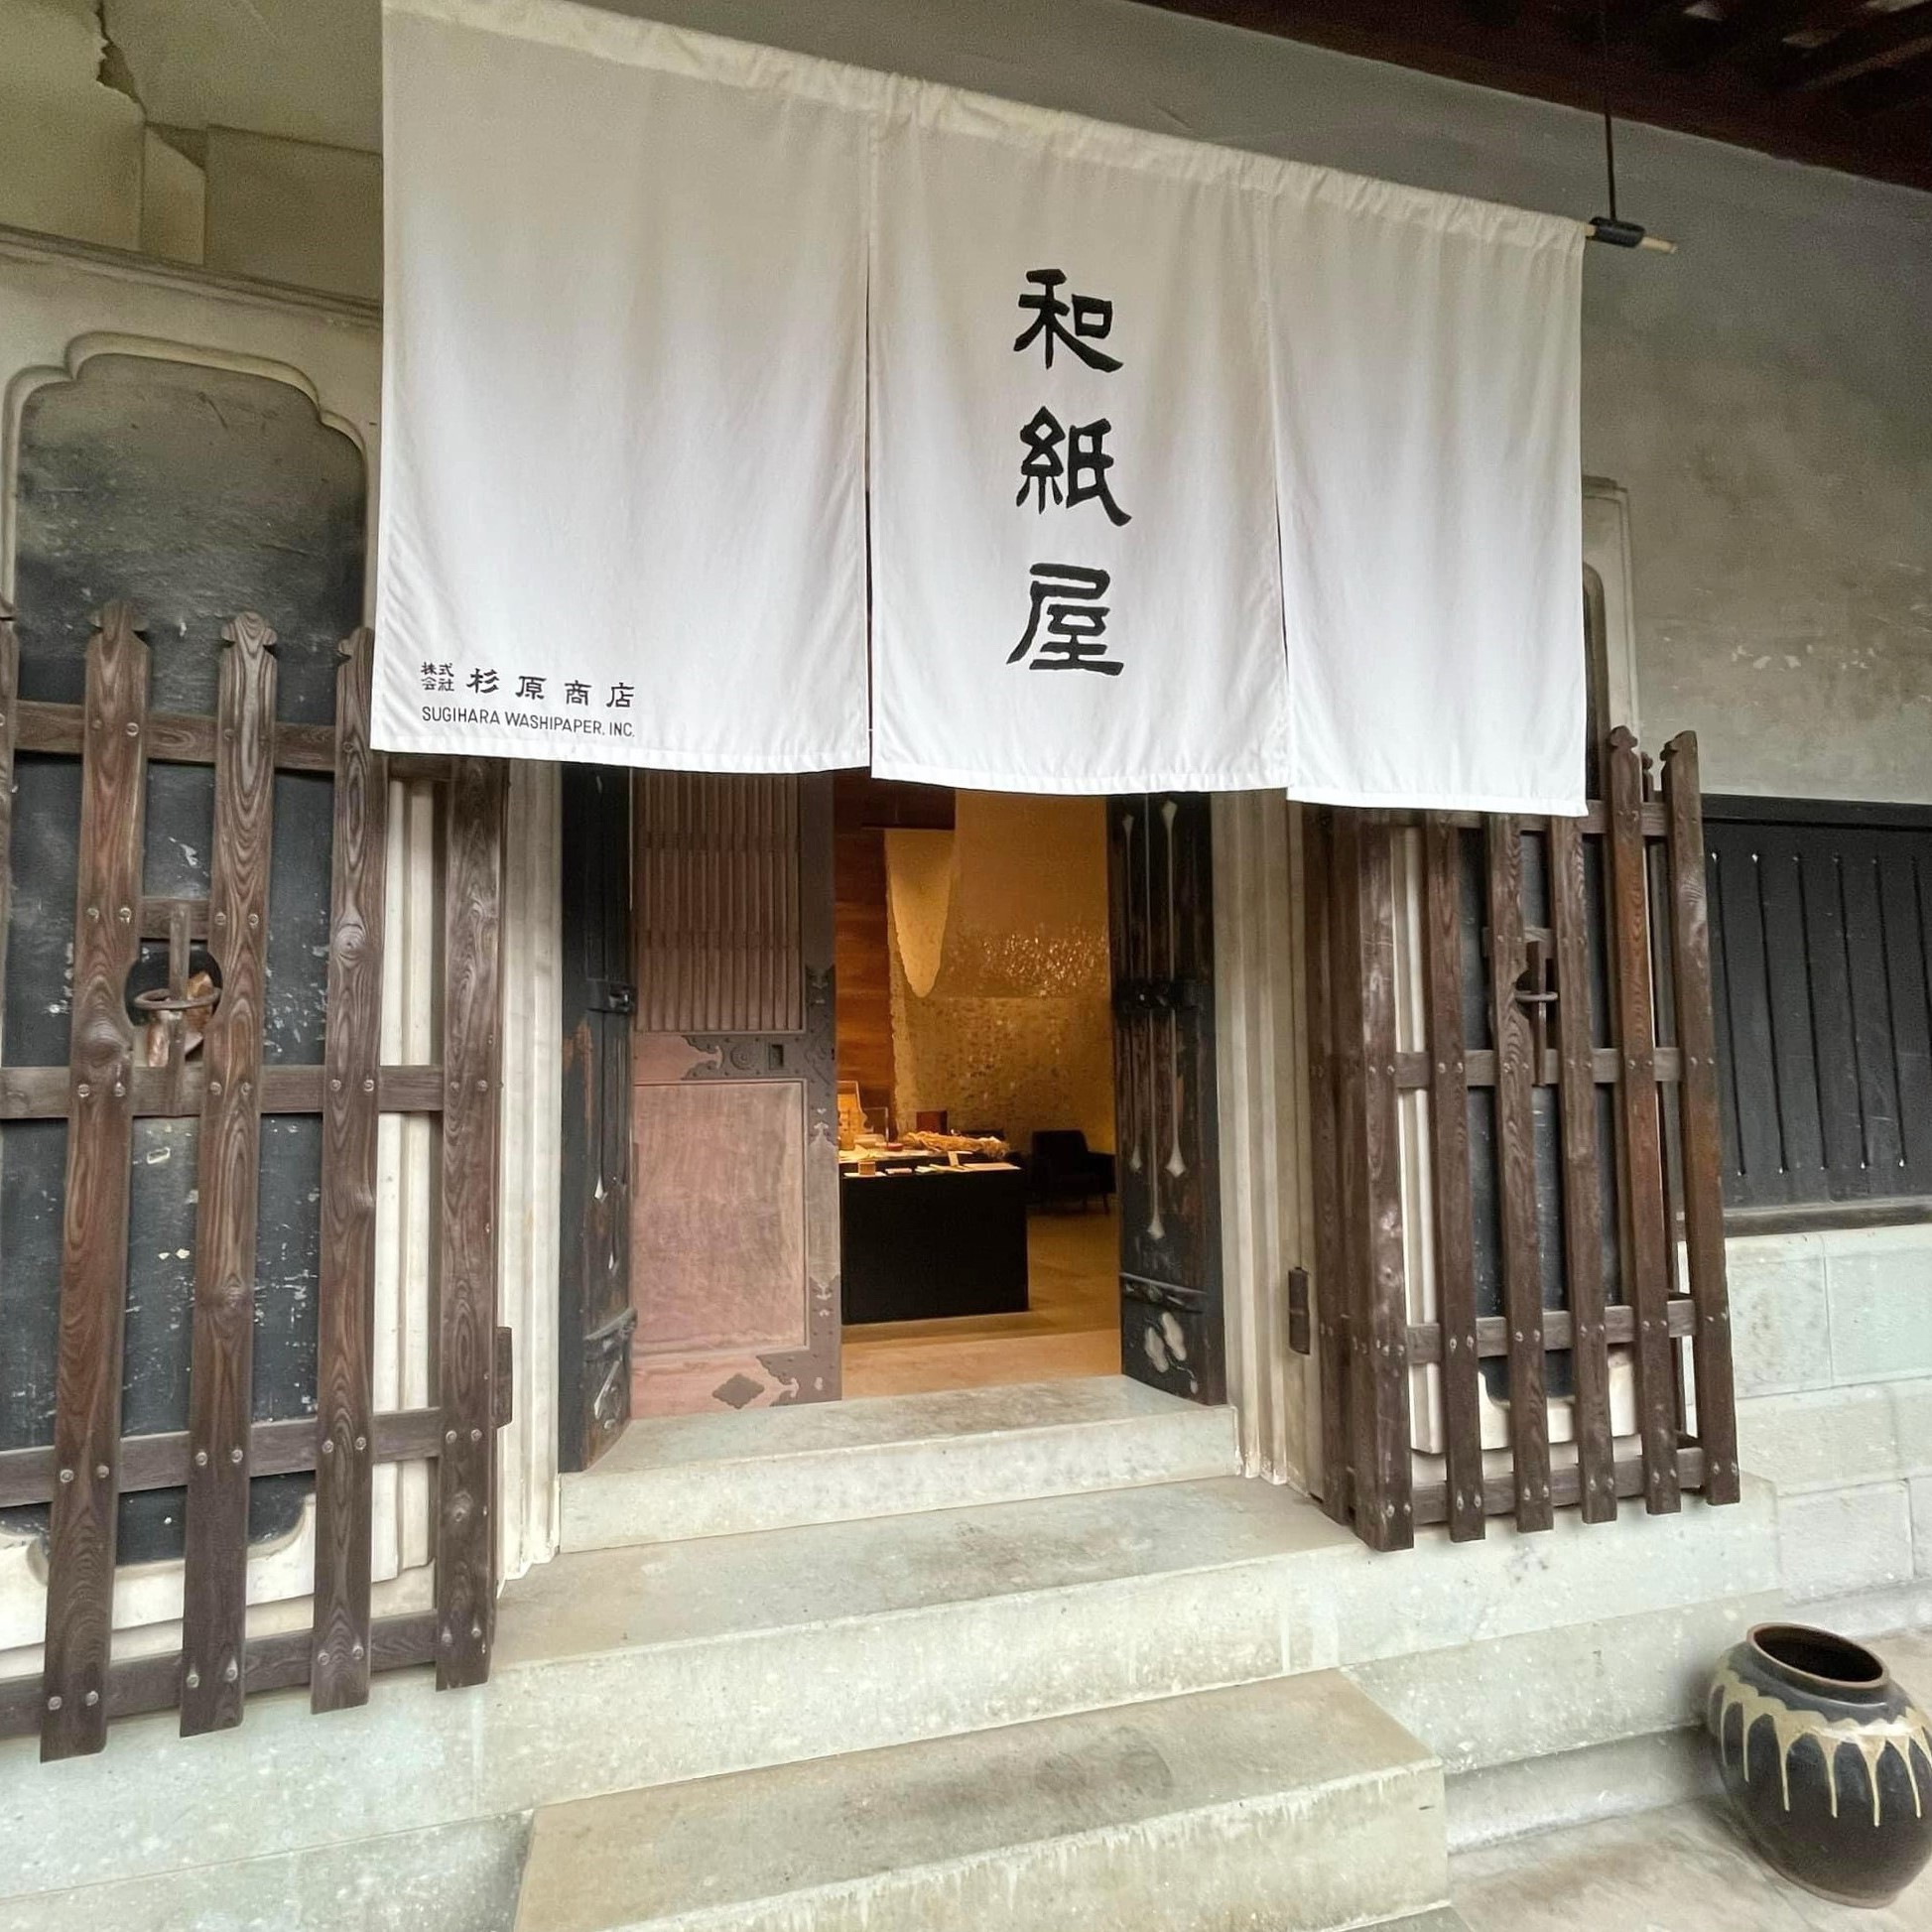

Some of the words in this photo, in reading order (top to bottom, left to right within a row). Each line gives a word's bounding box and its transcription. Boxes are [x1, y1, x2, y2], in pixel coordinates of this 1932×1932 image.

[1006, 268, 1132, 677] 和紙屋
[466, 668, 635, 708] 杉原商店
[422, 706, 500, 724] SUGIHARA
[609, 722, 635, 737] INC.
